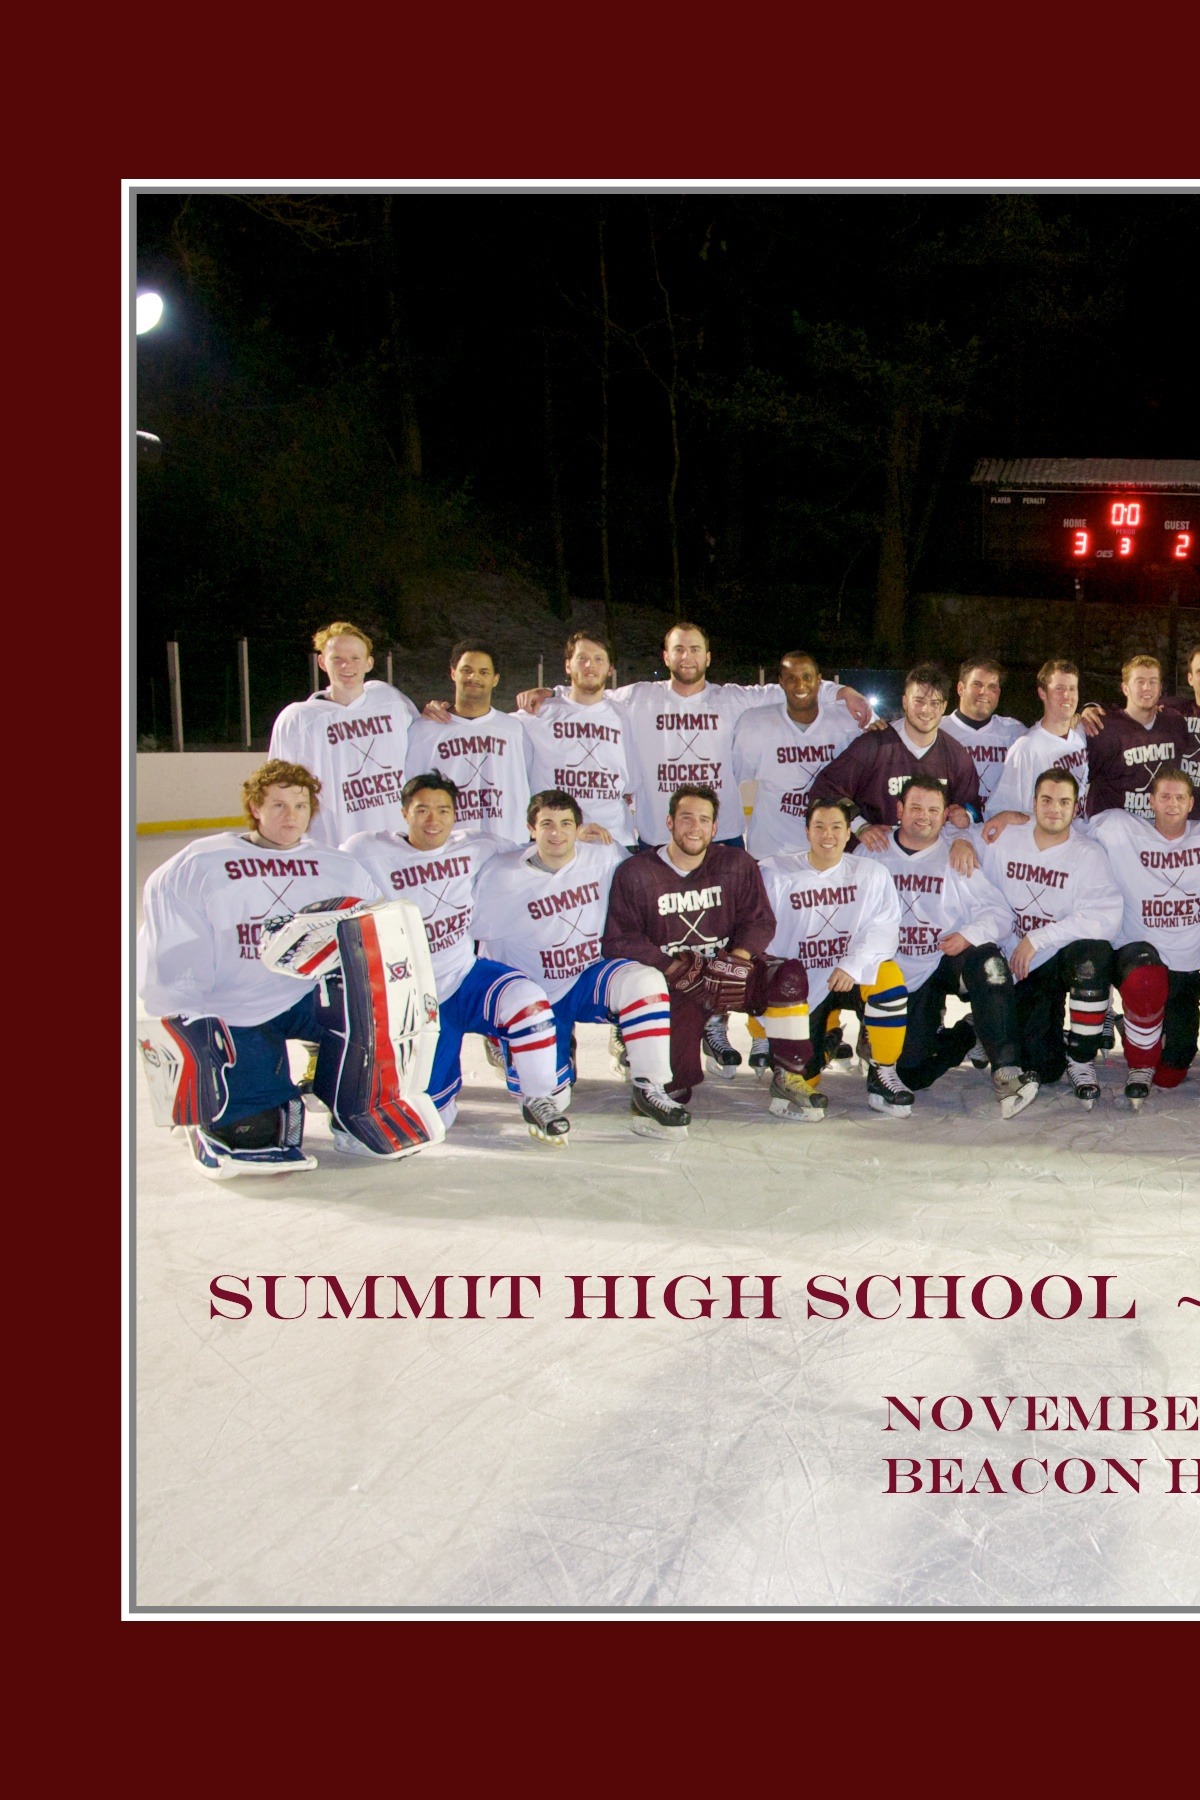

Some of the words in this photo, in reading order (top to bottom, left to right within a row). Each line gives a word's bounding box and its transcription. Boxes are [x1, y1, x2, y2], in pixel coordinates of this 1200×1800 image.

[1063, 518, 1087, 529] HOME
[1164, 520, 1190, 530] GUEST
[1074, 532, 1088, 555] 3
[1120, 537, 1131, 555] 3
[1175, 534, 1190, 557] 2
[327, 715, 393, 745] SUMMIT
[553, 722, 621, 744] SUMMIT
[656, 713, 719, 731] SUMMIT
[438, 735, 506, 760] SUMMIT
[776, 745, 836, 764] SUMMIT
[554, 768, 620, 790] HOCKEY
[657, 762, 722, 782] HOCKEY
[342, 769, 404, 801] HOCKEY
[596, 789, 621, 800] TEAM
[346, 795, 385, 814] ALUMNI
[385, 790, 402, 804] TEA
[780, 792, 810, 808] HOC
[780, 805, 807, 818] ALUM
[224, 858, 319, 880] SUMMIT
[390, 855, 472, 891] SUMMIT
[1006, 861, 1070, 890] SUMMIT
[527, 881, 600, 920] SUMMIT
[657, 885, 723, 916] SUMMIT
[789, 885, 858, 910] SUMMIT
[1143, 916, 1179, 928] ALUMNI
[428, 934, 456, 954] UMNI
[899, 926, 943, 945] CKEY
[539, 938, 600, 969] HOCKE
